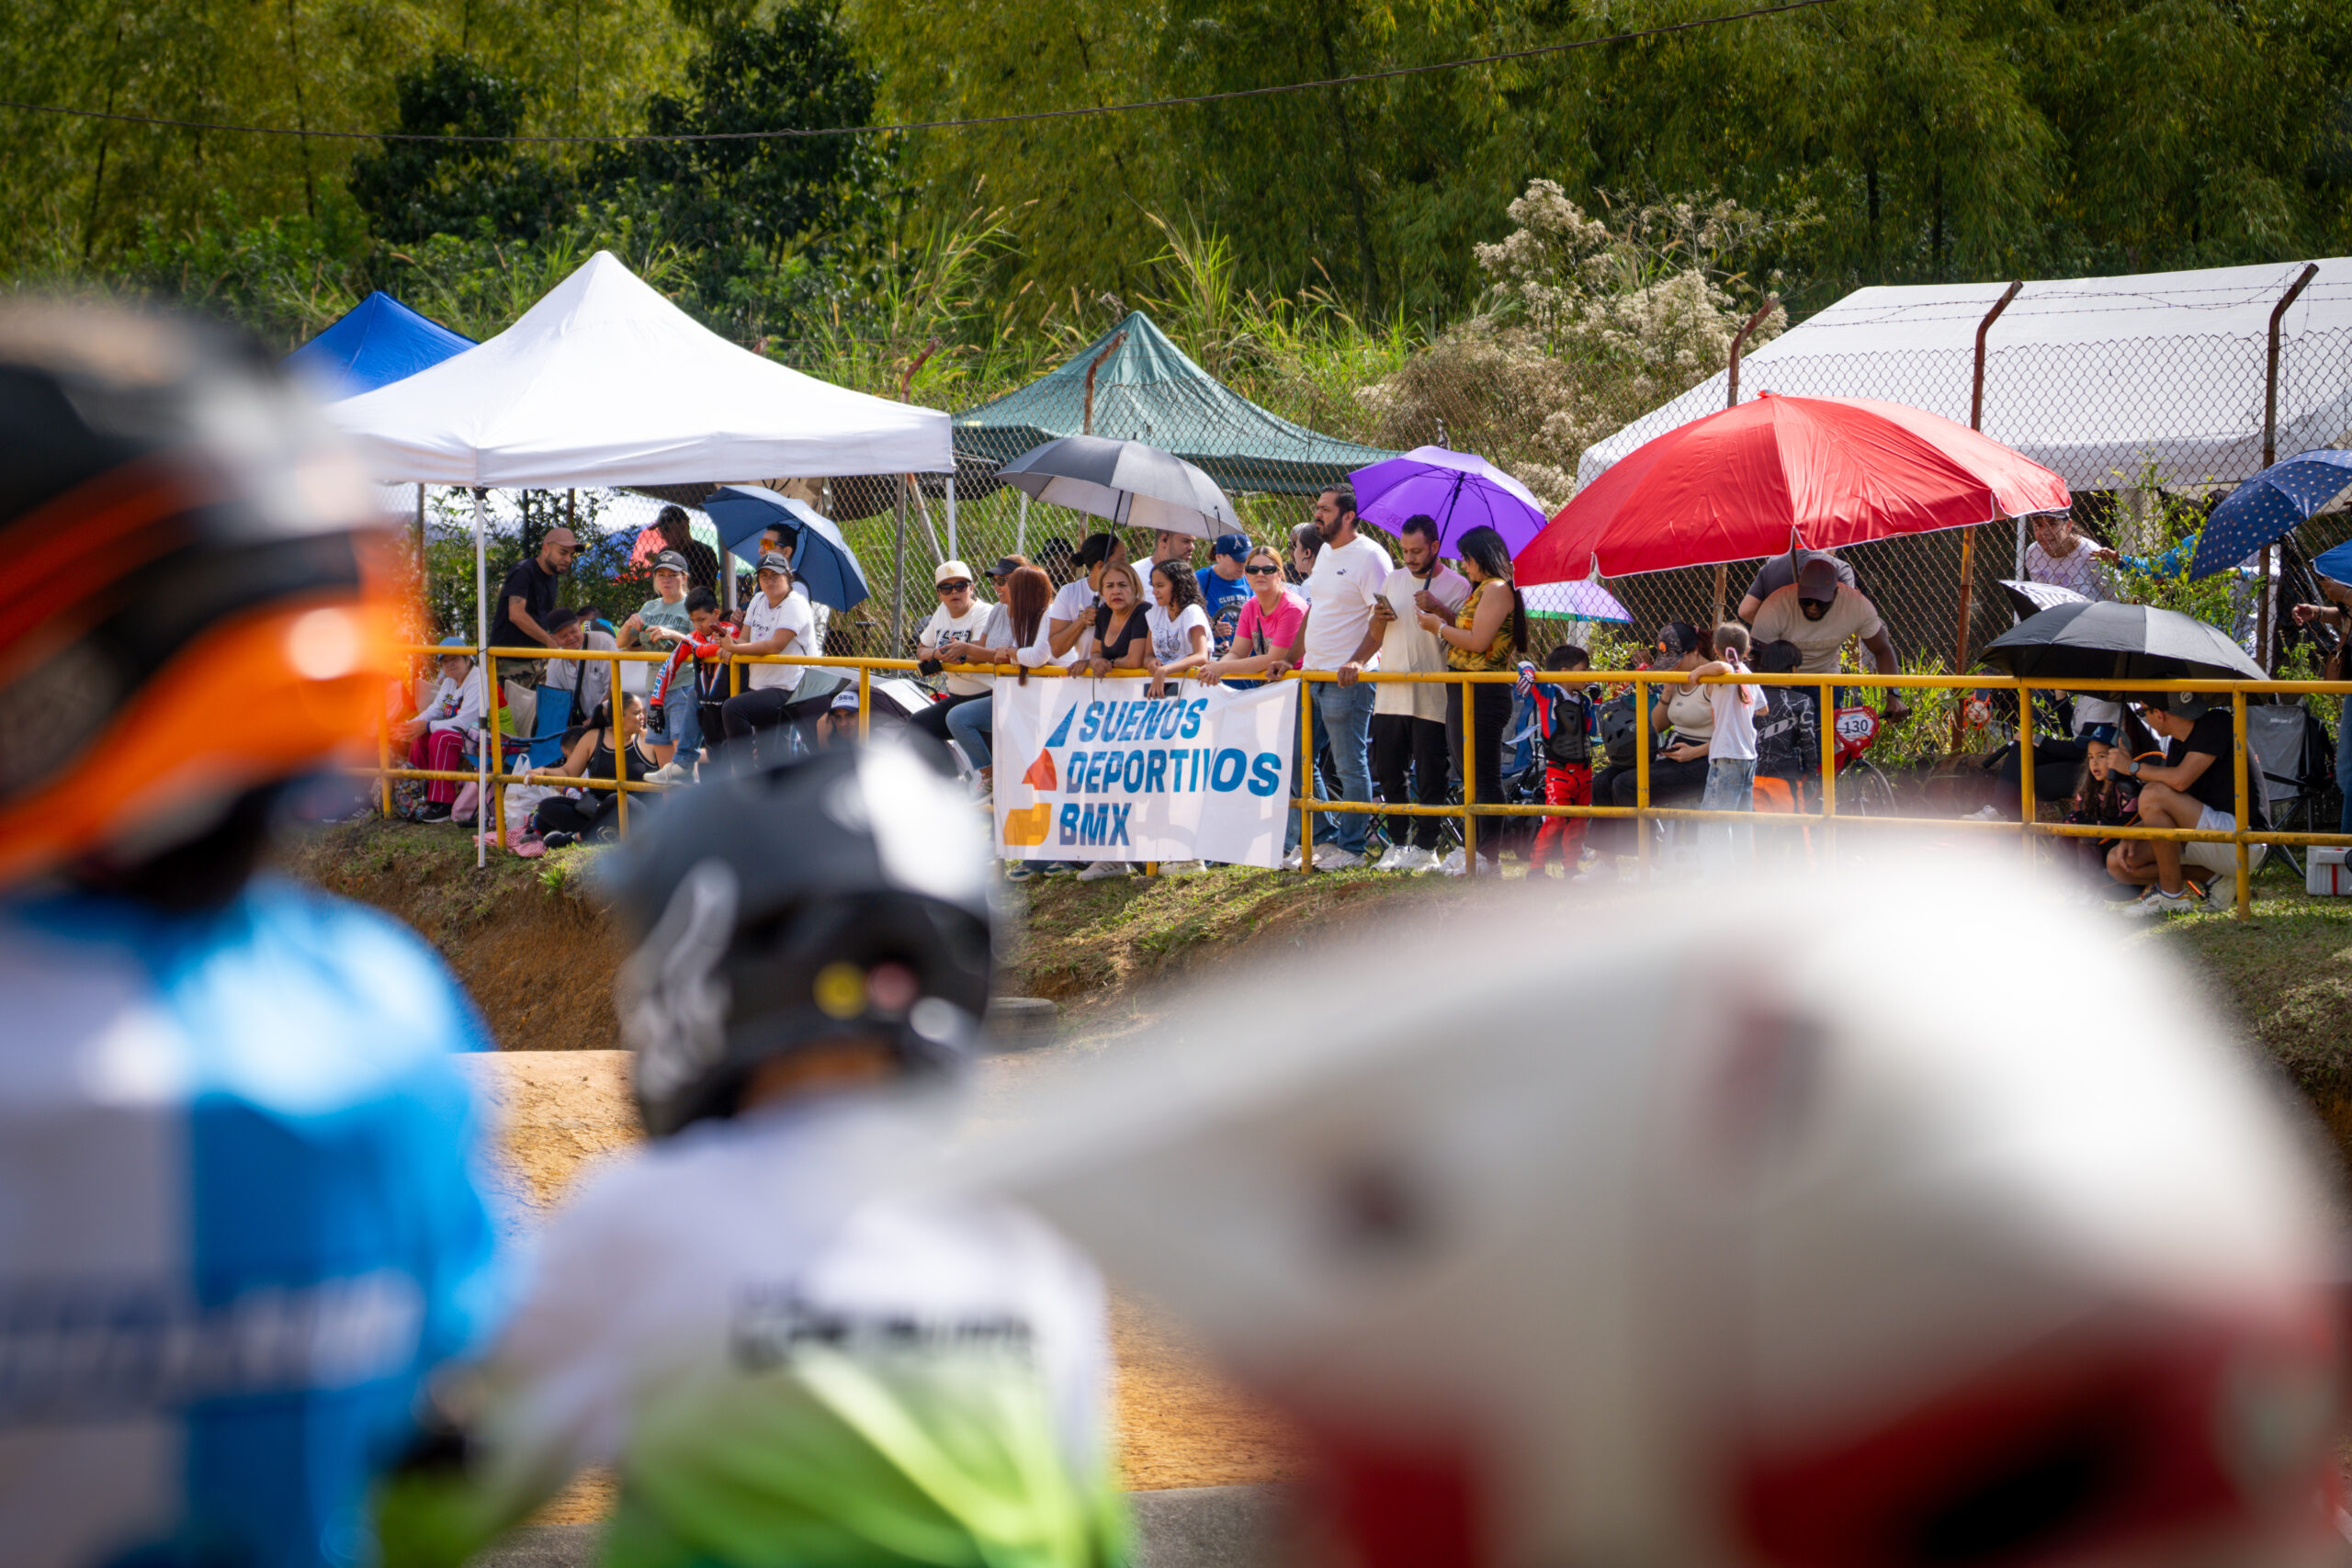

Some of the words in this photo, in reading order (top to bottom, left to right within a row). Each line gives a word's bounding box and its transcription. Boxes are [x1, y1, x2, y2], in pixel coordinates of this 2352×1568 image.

[1218, 594, 1236, 604] CLUB
[1079, 698, 1208, 742] SUENOS
[1844, 719, 1869, 734] 130
[1066, 748, 1282, 796] DEPORTIVOS
[1059, 802, 1132, 846] BMX
